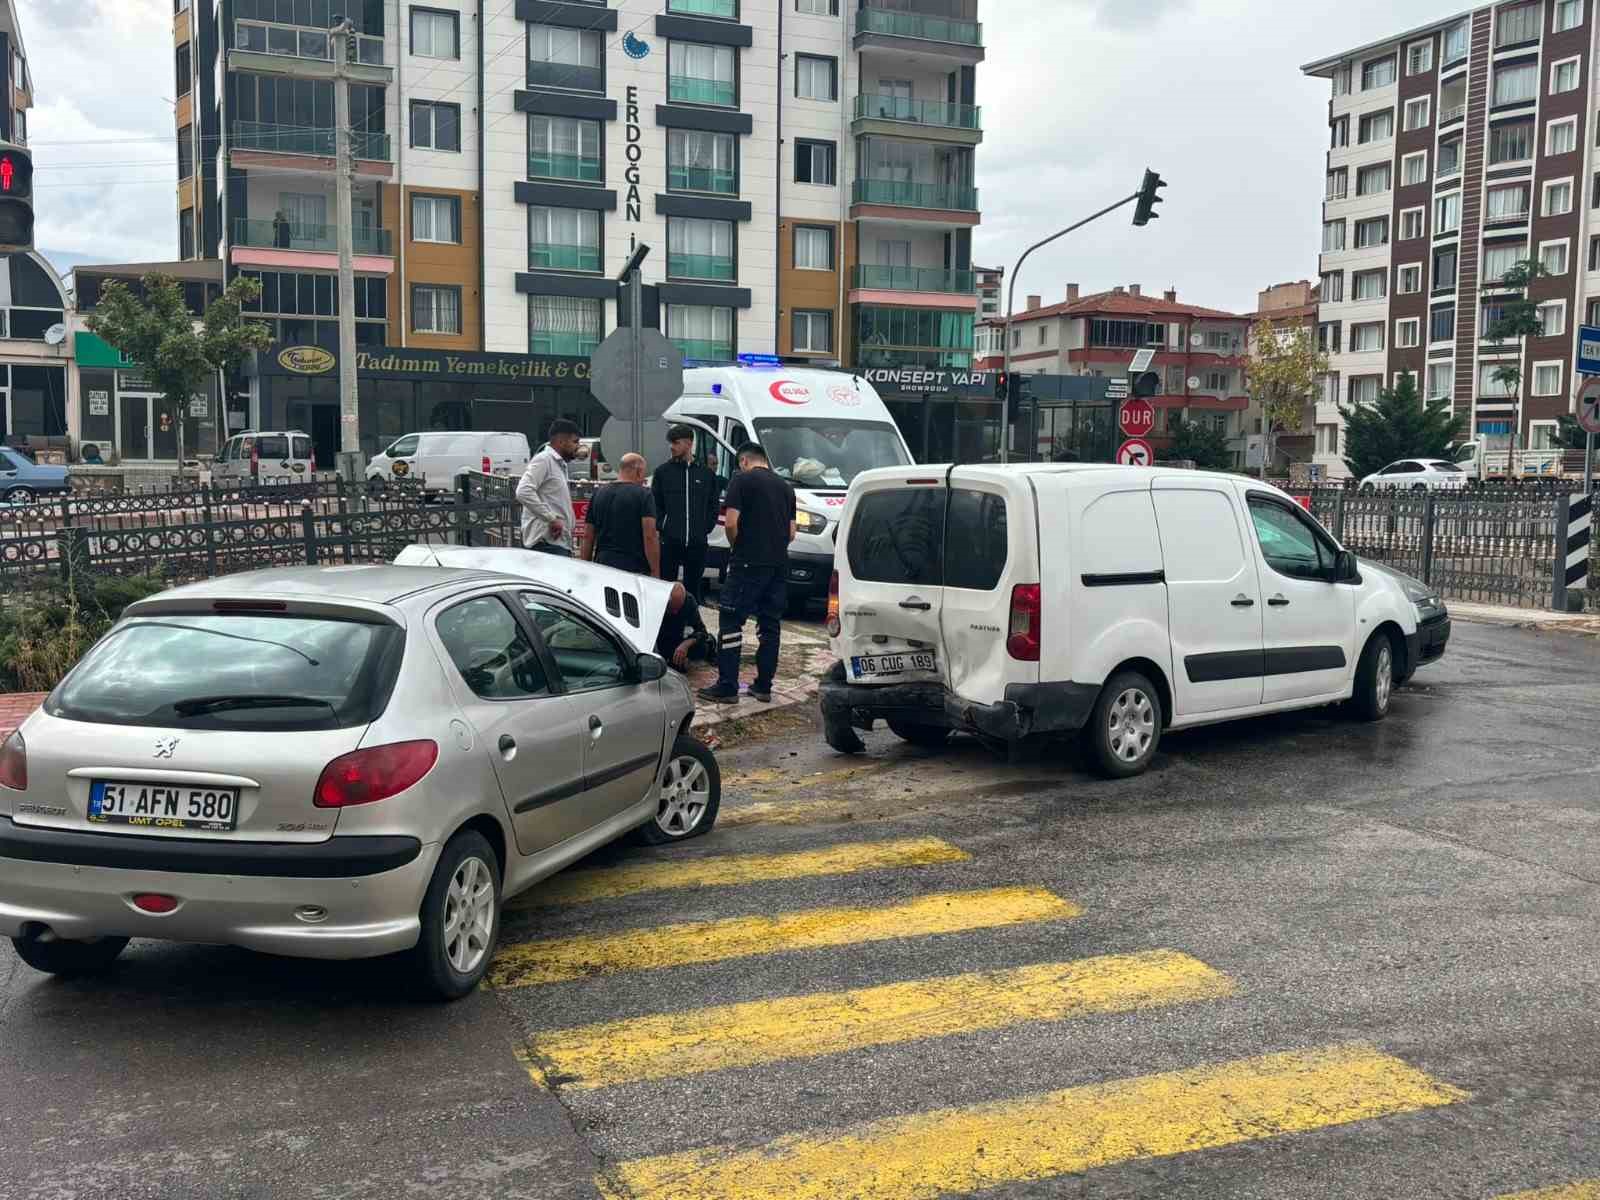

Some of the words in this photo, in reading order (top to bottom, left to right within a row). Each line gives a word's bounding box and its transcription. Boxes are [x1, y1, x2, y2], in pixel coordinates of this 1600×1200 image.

[625, 86, 642, 222] ERDOĞAN
[357, 352, 440, 373] Tadımm
[445, 356, 551, 379] Yemekçilik
[555, 362, 569, 378] &
[864, 369, 946, 384] KONSEPT
[951, 372, 987, 385] YAPI
[900, 384, 949, 392] SHOWROOM
[1121, 409, 1152, 425] DUR
[861, 658, 876, 672] 06
[881, 655, 905, 670] CUG
[910, 655, 932, 668] 189
[102, 786, 126, 813] 51
[135, 788, 180, 816] AFN
[187, 791, 232, 820] 580
[155, 818, 185, 828] OPEL
